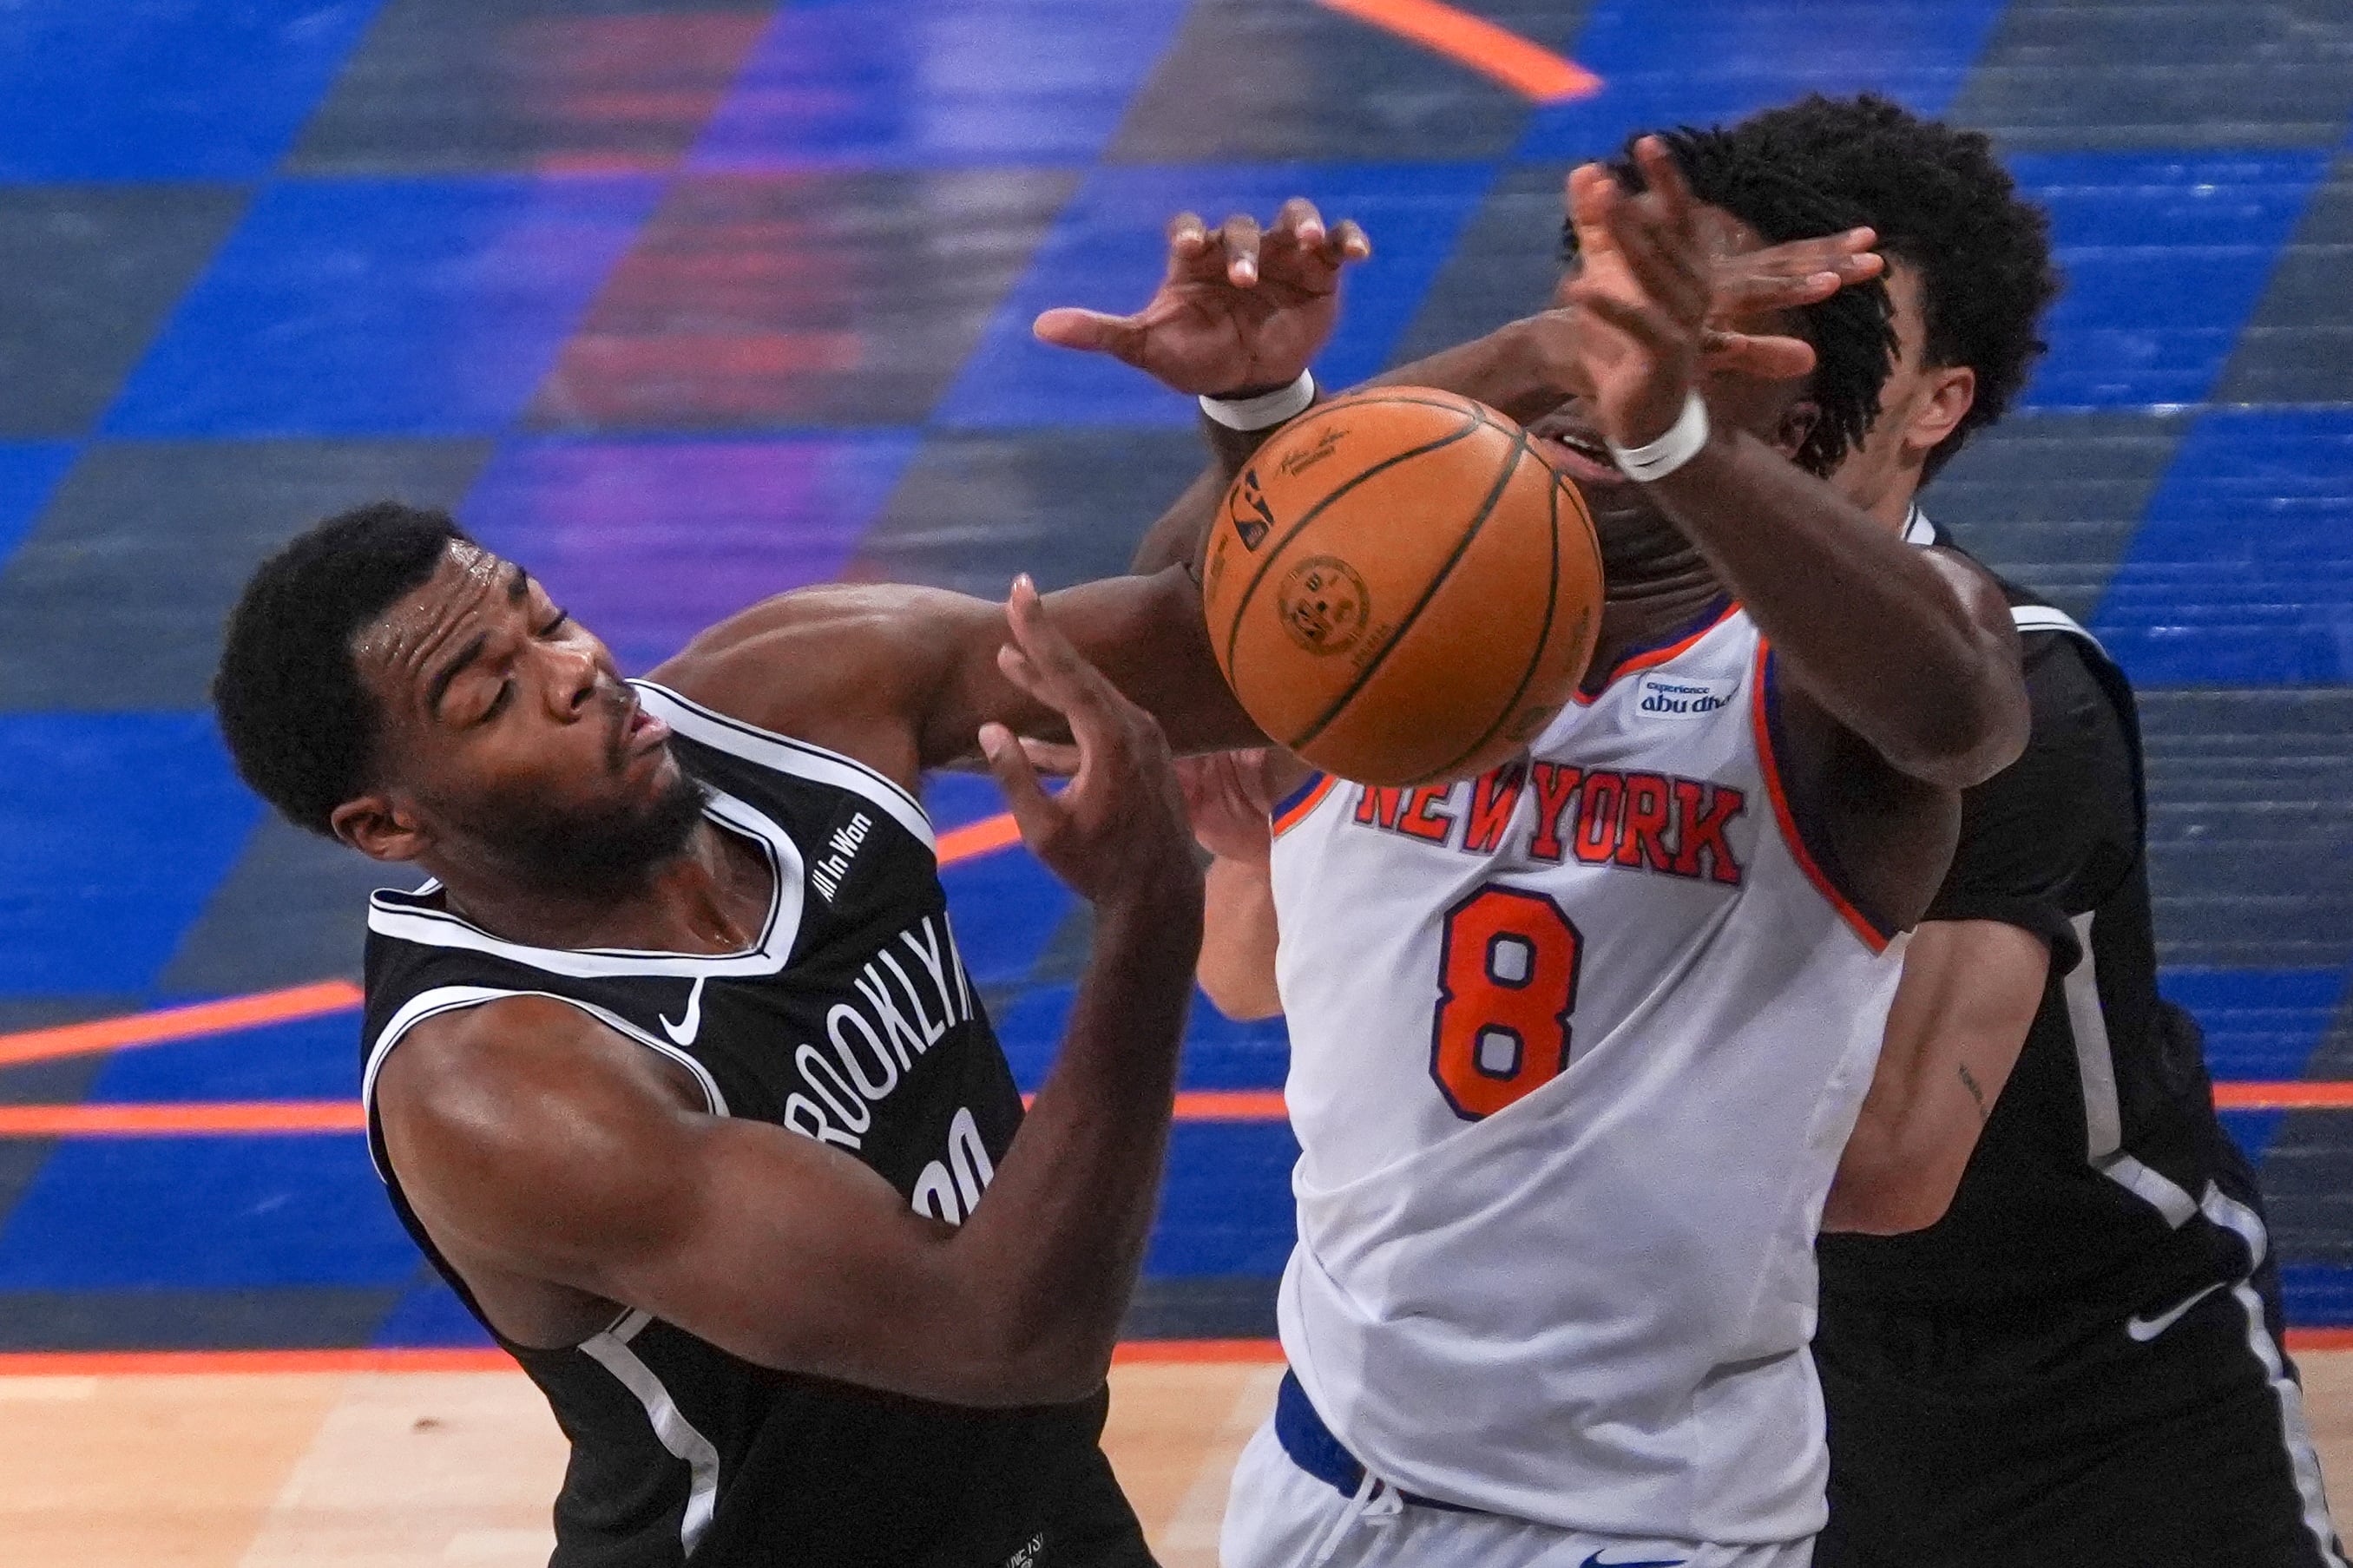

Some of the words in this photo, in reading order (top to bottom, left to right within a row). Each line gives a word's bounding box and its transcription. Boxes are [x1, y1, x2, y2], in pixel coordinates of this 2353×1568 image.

[1640, 694, 1687, 713] abu
[828, 811, 872, 858] Won
[1528, 758, 1745, 889] YORK
[812, 869, 838, 903] All
[817, 854, 849, 881] In
[1429, 882, 1585, 1123] 8
[784, 910, 975, 1151] ROOKLY
